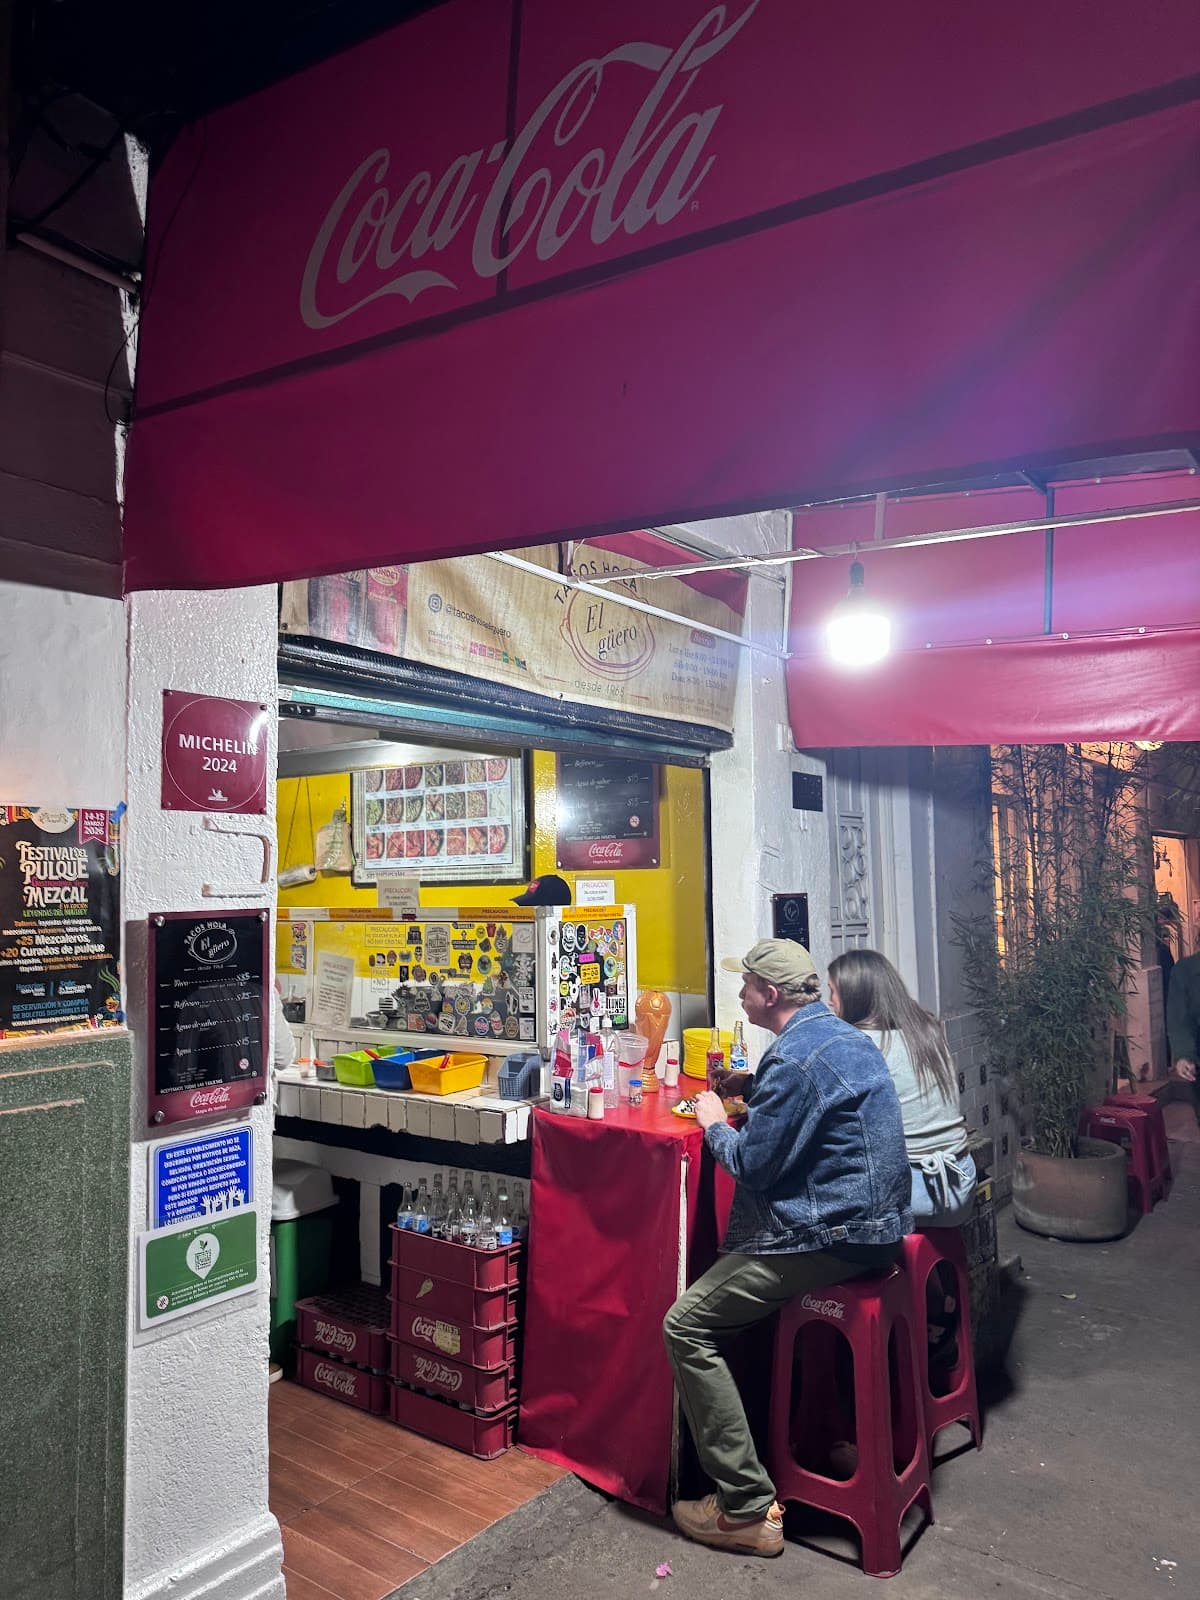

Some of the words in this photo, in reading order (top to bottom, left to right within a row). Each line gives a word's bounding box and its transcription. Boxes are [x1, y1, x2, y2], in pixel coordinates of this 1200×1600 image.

[300, 0, 760, 329] Coca-Cola
[554, 560, 597, 604] TAOS
[586, 601, 604, 634] El
[599, 626, 637, 661] güero
[574, 680, 601, 693] desde
[178, 733, 259, 756] MICHELIN
[202, 757, 238, 773] 2024
[15, 840, 74, 863] FESTIVAL
[589, 842, 623, 858] Coca-Cola
[20, 858, 89, 884] PULQUE
[23, 886, 88, 908] MEZCAL
[184, 923, 205, 944] TACOS
[207, 921, 226, 929] HOLA
[201, 936, 210, 950] El
[20, 945, 60, 957] Curados
[61, 944, 73, 954] de
[74, 943, 105, 955] pulque
[208, 940, 230, 958] güero
[12, 1001, 56, 1012] RESERVACIÓN
[62, 998, 89, 1007] COMPRA
[190, 1086, 232, 1108] Coca-Cola
[174, 1149, 186, 1157] ESTE
[186, 1140, 226, 1154] ESTABLECIMIENTO
[202, 1149, 222, 1160] MOTIVOS
[800, 1294, 846, 1321] Coca-Cola
[315, 1321, 356, 1352] Coca-Cola
[314, 1363, 357, 1396] Coca-Cola
[414, 1357, 463, 1391] Coca-Cola
